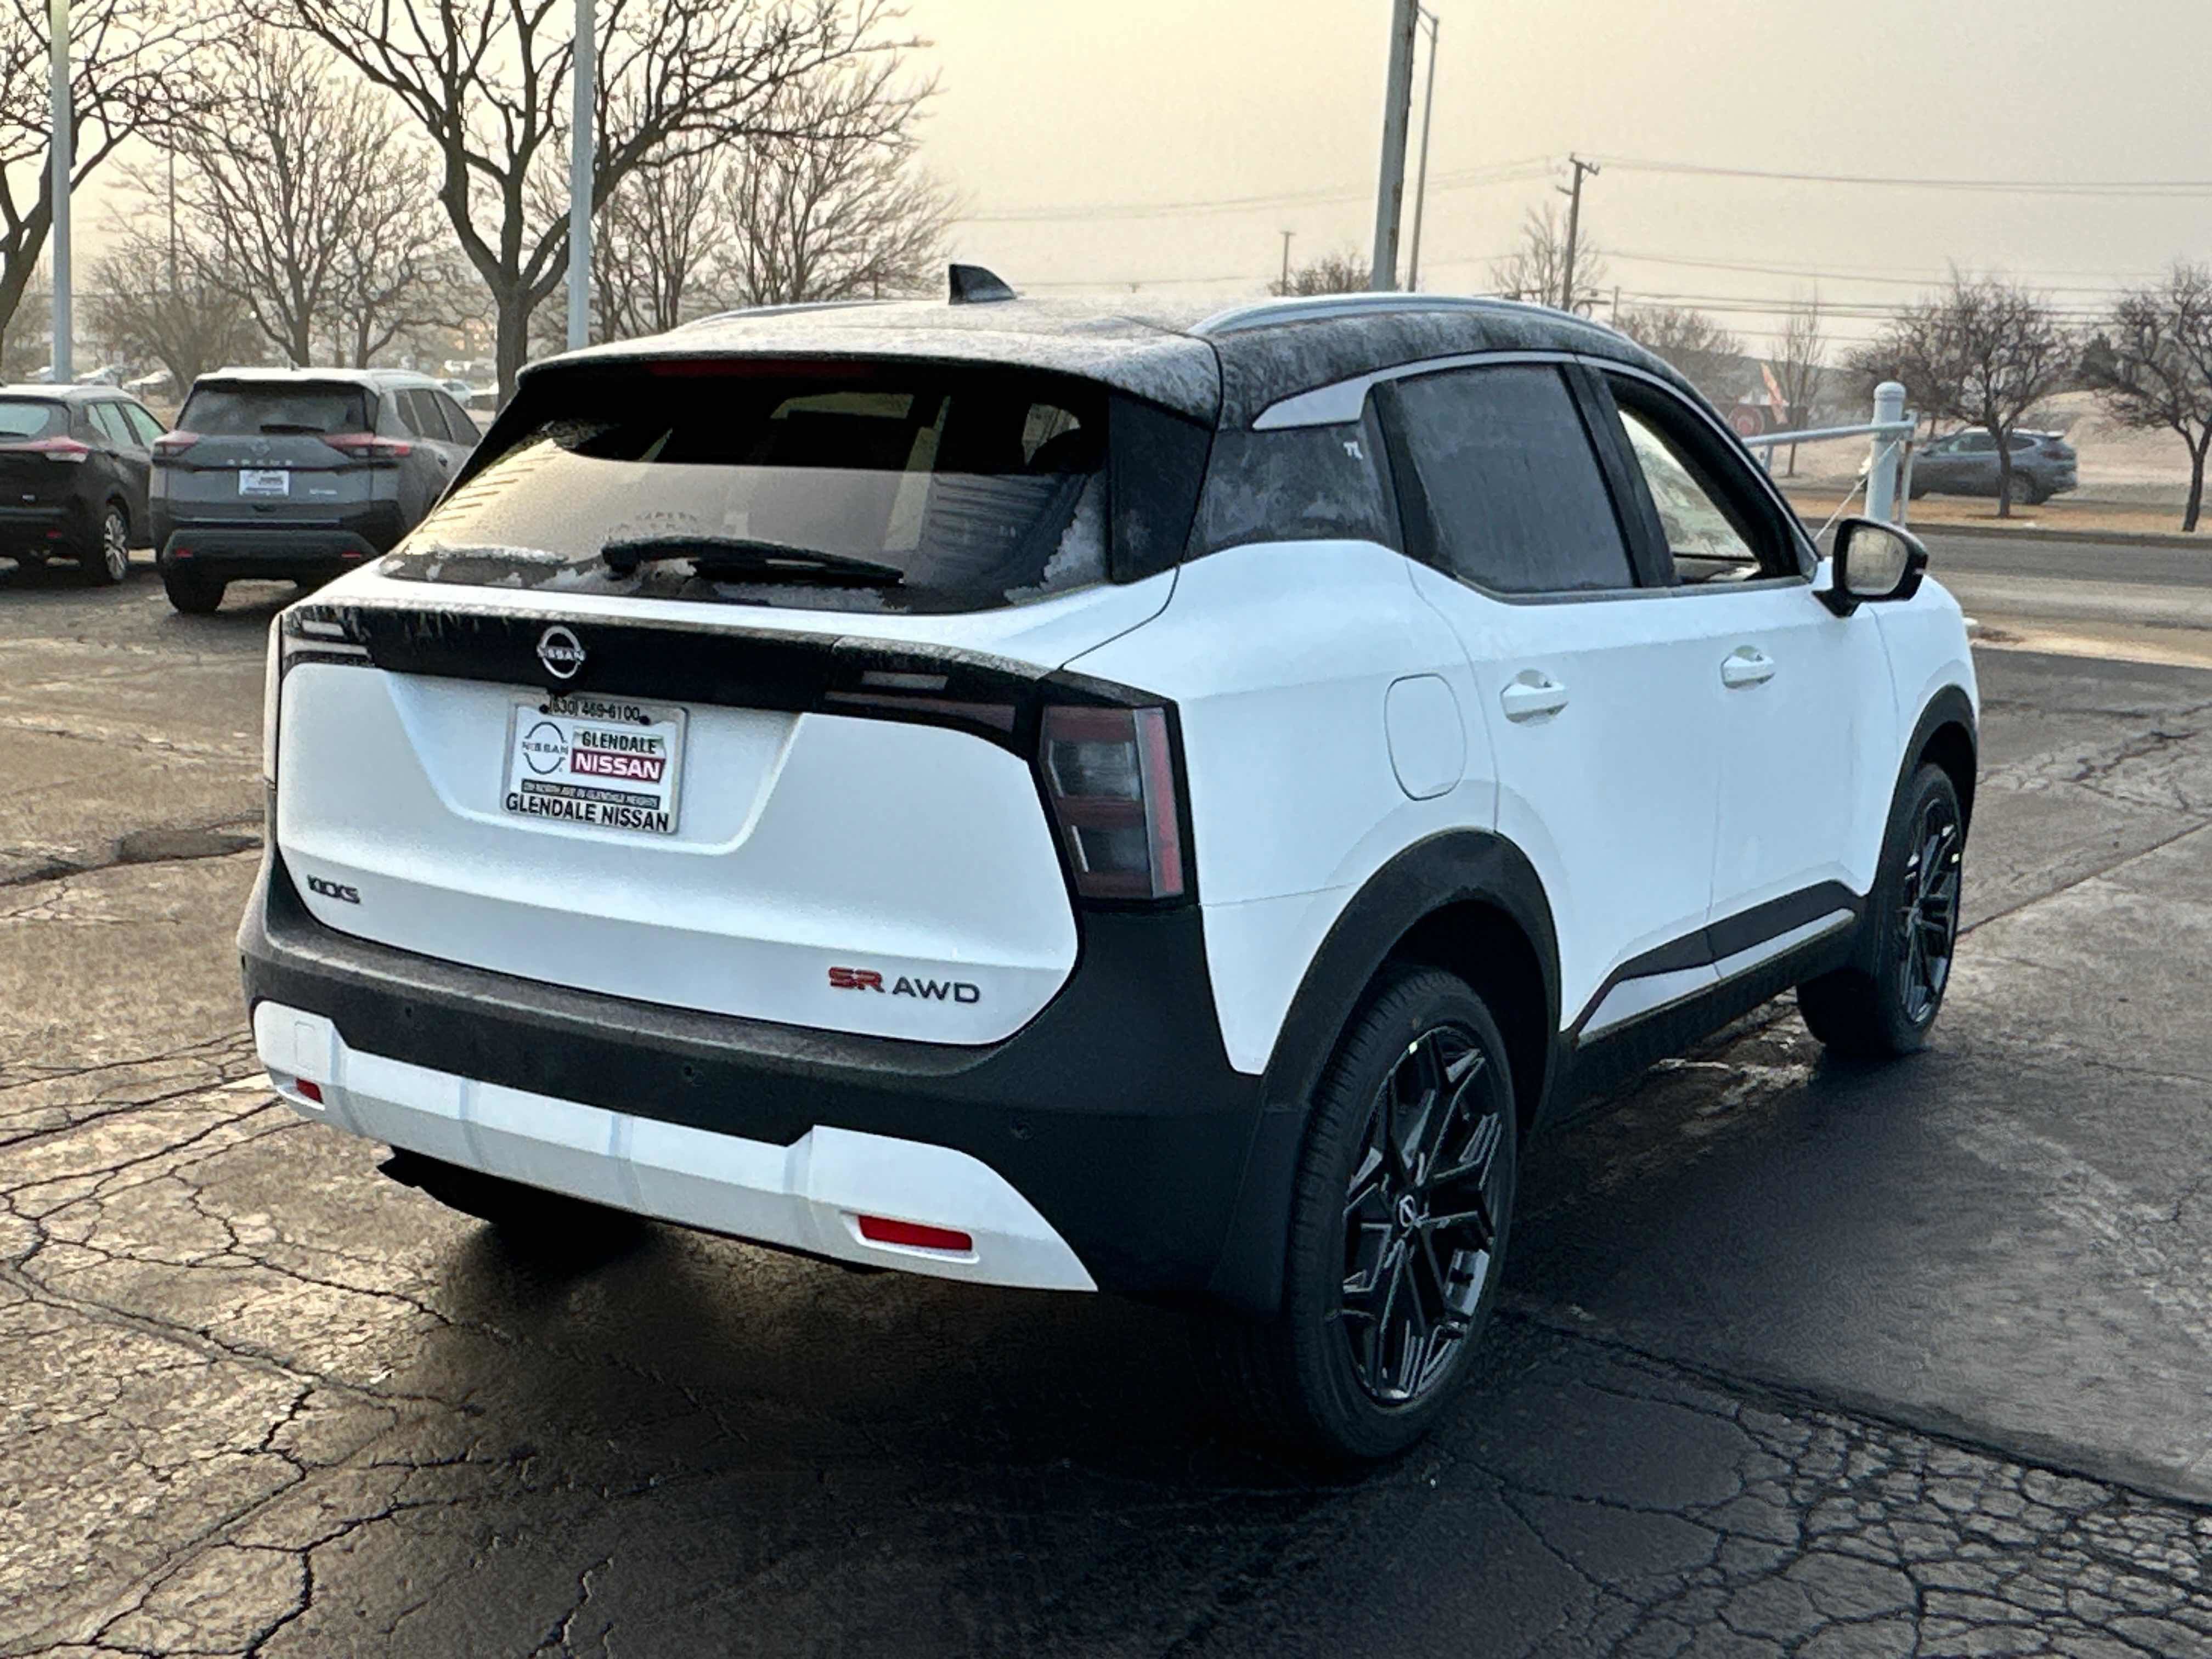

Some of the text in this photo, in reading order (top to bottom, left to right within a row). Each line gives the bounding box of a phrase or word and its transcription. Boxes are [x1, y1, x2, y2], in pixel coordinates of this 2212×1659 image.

[582, 731, 657, 754] GLENDALE
[575, 752, 661, 779] NISSAN
[506, 793, 597, 822] GLENDALE
[602, 804, 669, 832] NISSAN
[828, 966, 980, 1004] SR AWD
